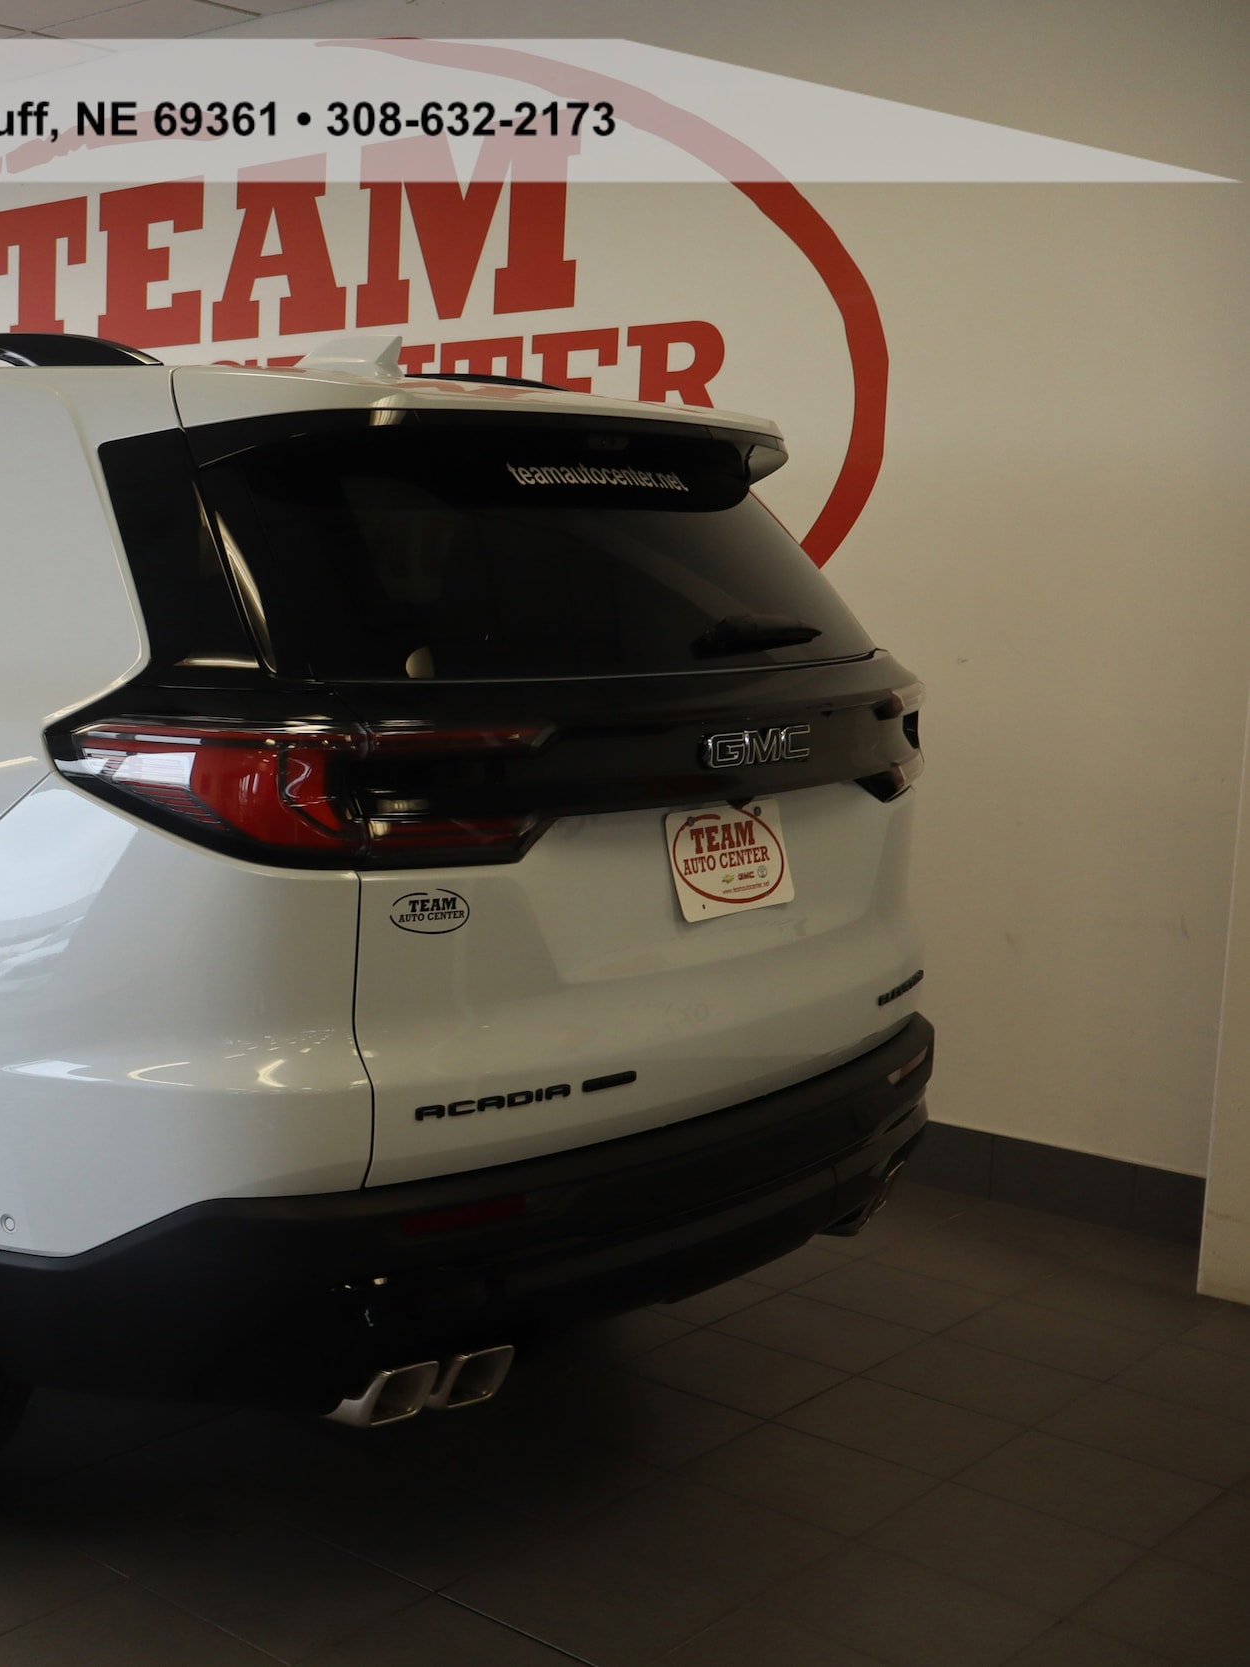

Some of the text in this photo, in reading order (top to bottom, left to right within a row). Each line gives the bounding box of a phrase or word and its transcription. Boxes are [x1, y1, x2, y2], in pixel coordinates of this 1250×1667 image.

[506, 462, 689, 492] teamautocenter.net
[707, 724, 811, 769] GMC
[690, 820, 756, 854] TEAM
[683, 845, 770, 876] AUTO CENTER
[398, 910, 465, 923] AUTO CENTER
[408, 897, 457, 913] TEAM
[415, 1083, 571, 1121] ACADIA
